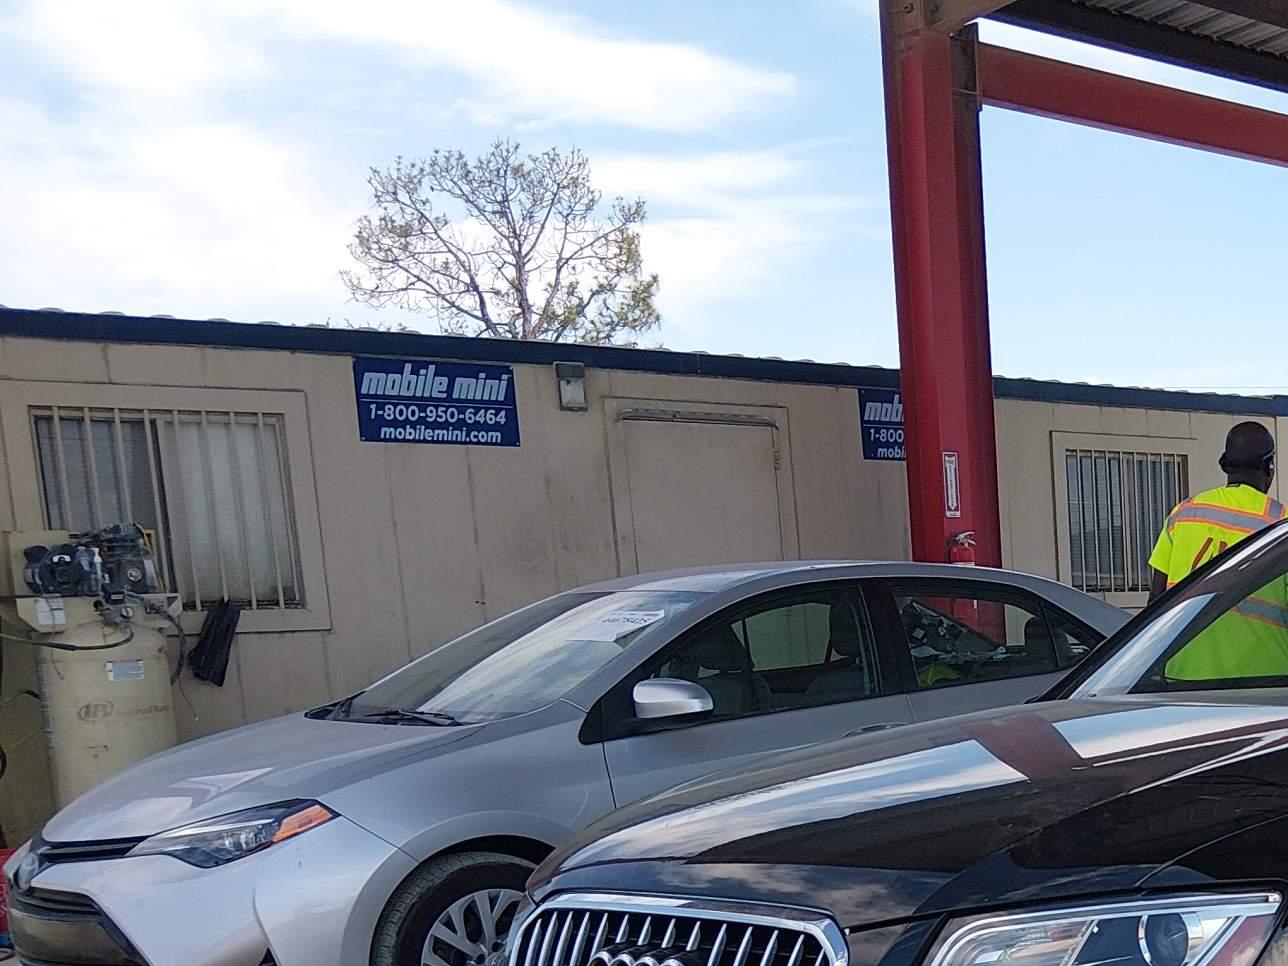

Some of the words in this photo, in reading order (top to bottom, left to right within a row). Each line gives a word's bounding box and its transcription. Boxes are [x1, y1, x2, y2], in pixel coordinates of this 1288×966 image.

[360, 363, 449, 398] mobile
[452, 373, 508, 401] mini
[369, 404, 506, 424] 1-800-950-6464
[864, 394, 904, 422] mob
[380, 425, 502, 443] mobilemini.com
